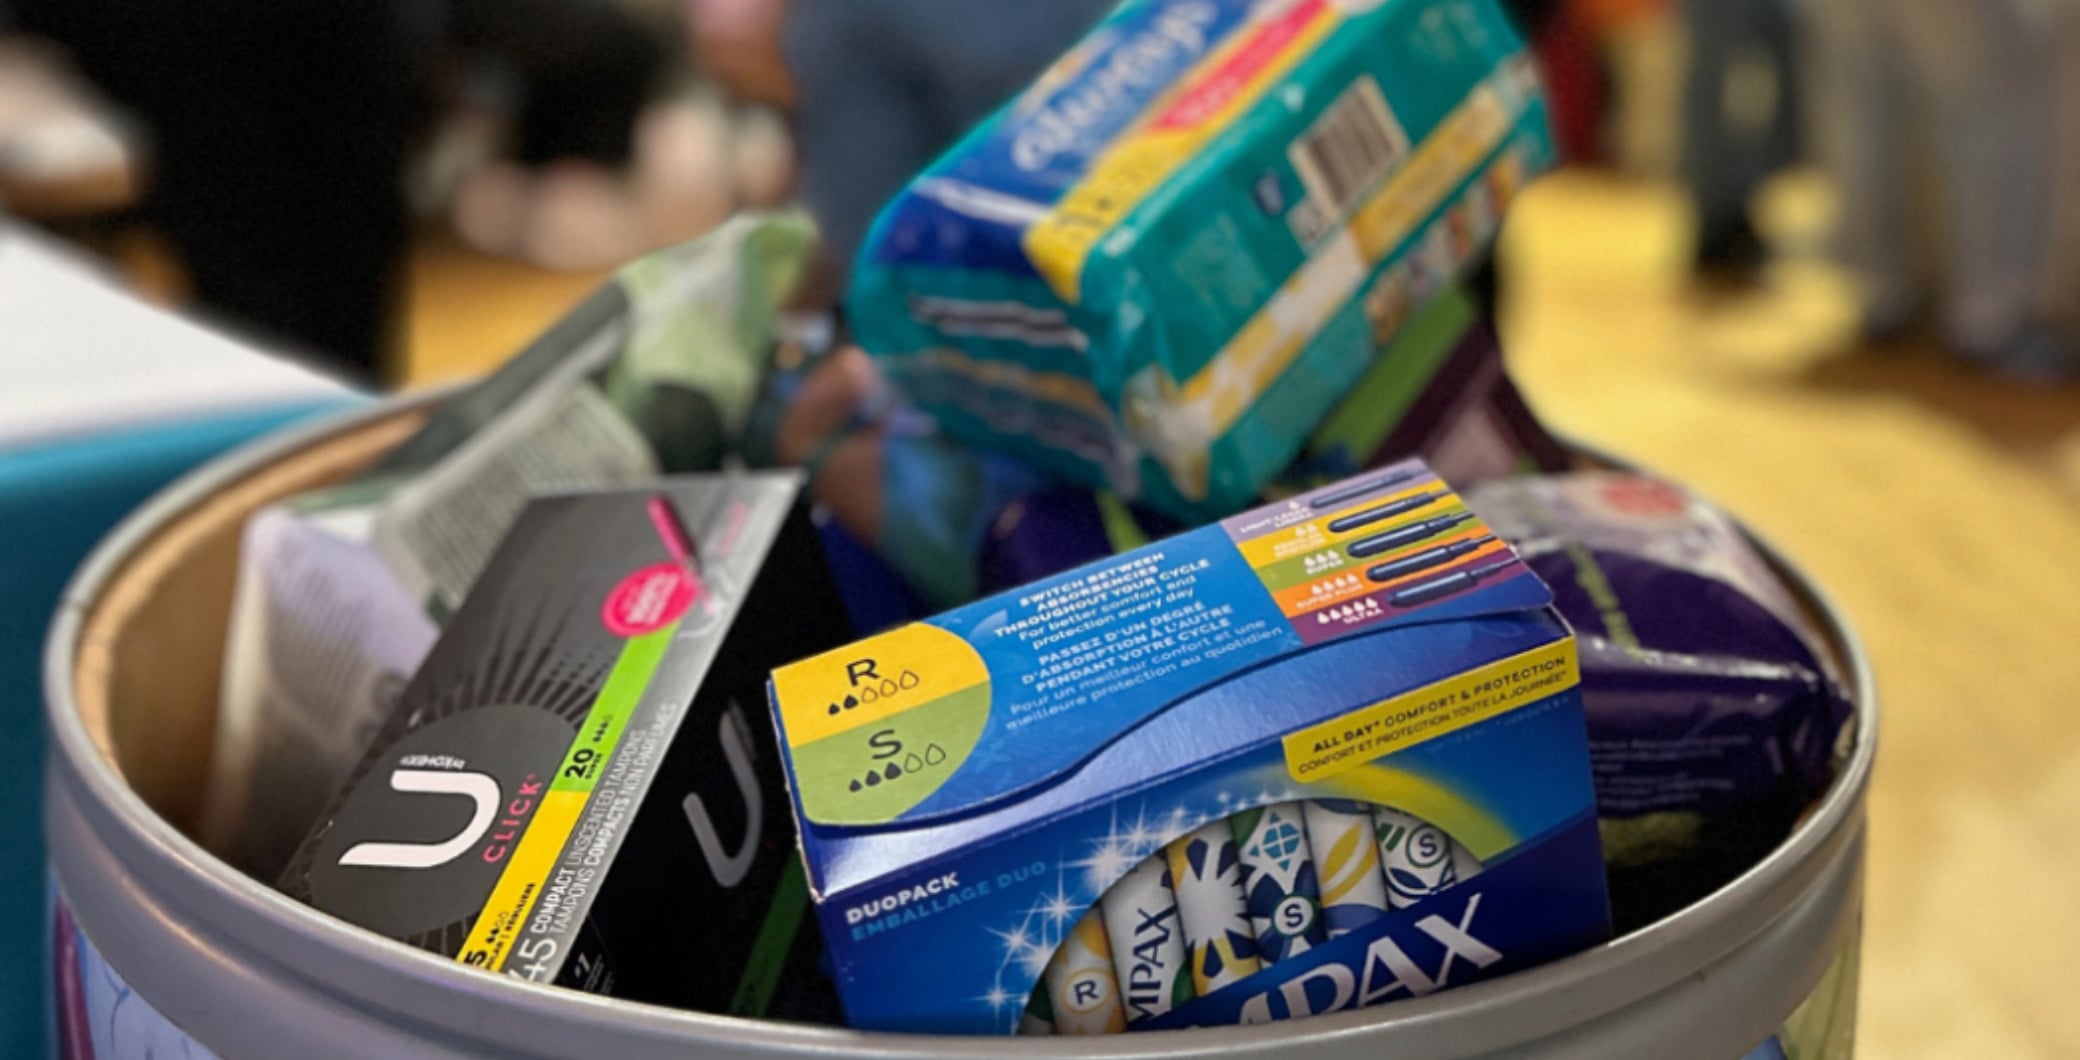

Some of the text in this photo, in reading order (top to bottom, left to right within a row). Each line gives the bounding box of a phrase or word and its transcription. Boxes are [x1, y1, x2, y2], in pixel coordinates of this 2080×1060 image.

[993, 559, 1210, 638] THROUGHOUT YOUR CYCLE
[1019, 551, 1165, 607] SWITCH BETWEEN
[1019, 575, 1196, 641] For better comfort and
[1036, 565, 1159, 613] ABSORBENCIES
[1021, 633, 1147, 685] D'ABSORPTION
[1165, 603, 1233, 632] L'AUTRE
[1033, 588, 1195, 651] protection every day
[1038, 636, 1101, 666] PASSEZ
[1103, 621, 1147, 644] D'UN
[1343, 608, 1384, 624] ULTRA
[846, 658, 880, 687] R
[1006, 625, 1282, 731] meilleure protection au quotidien
[1010, 619, 1266, 715] Pour un meilleur confort et une
[1036, 617, 1232, 692] PENDANT VOTRE CYCLE
[1298, 746, 1356, 773] CONFORT
[1357, 739, 1373, 752] ET
[1375, 713, 1451, 748] PROTECTION
[1452, 699, 1490, 719] TOUTE
[1491, 692, 1506, 705] LA
[1312, 736, 1340, 754] ALL
[1384, 694, 1456, 728] COMFORT
[1460, 689, 1471, 700] &
[1473, 656, 1565, 696] PROTECTION
[564, 748, 594, 778] 20
[584, 753, 603, 780] SUPER
[869, 729, 903, 759] S
[338, 769, 500, 868] U
[483, 780, 542, 863] CLICK
[530, 729, 647, 933] COMPACT UNSCENTED TAMPONS
[1418, 833, 1438, 857] S
[551, 868, 595, 933] TAMPONS
[584, 797, 631, 866] COMPACTS
[620, 768, 645, 796] NON
[845, 871, 960, 925] DUOPACK
[851, 861, 1046, 941] EMBALLAGE DUO
[1284, 903, 1304, 928] S
[464, 950, 488, 967] 5
[508, 938, 557, 982] 45
[1073, 979, 1099, 1004] R
